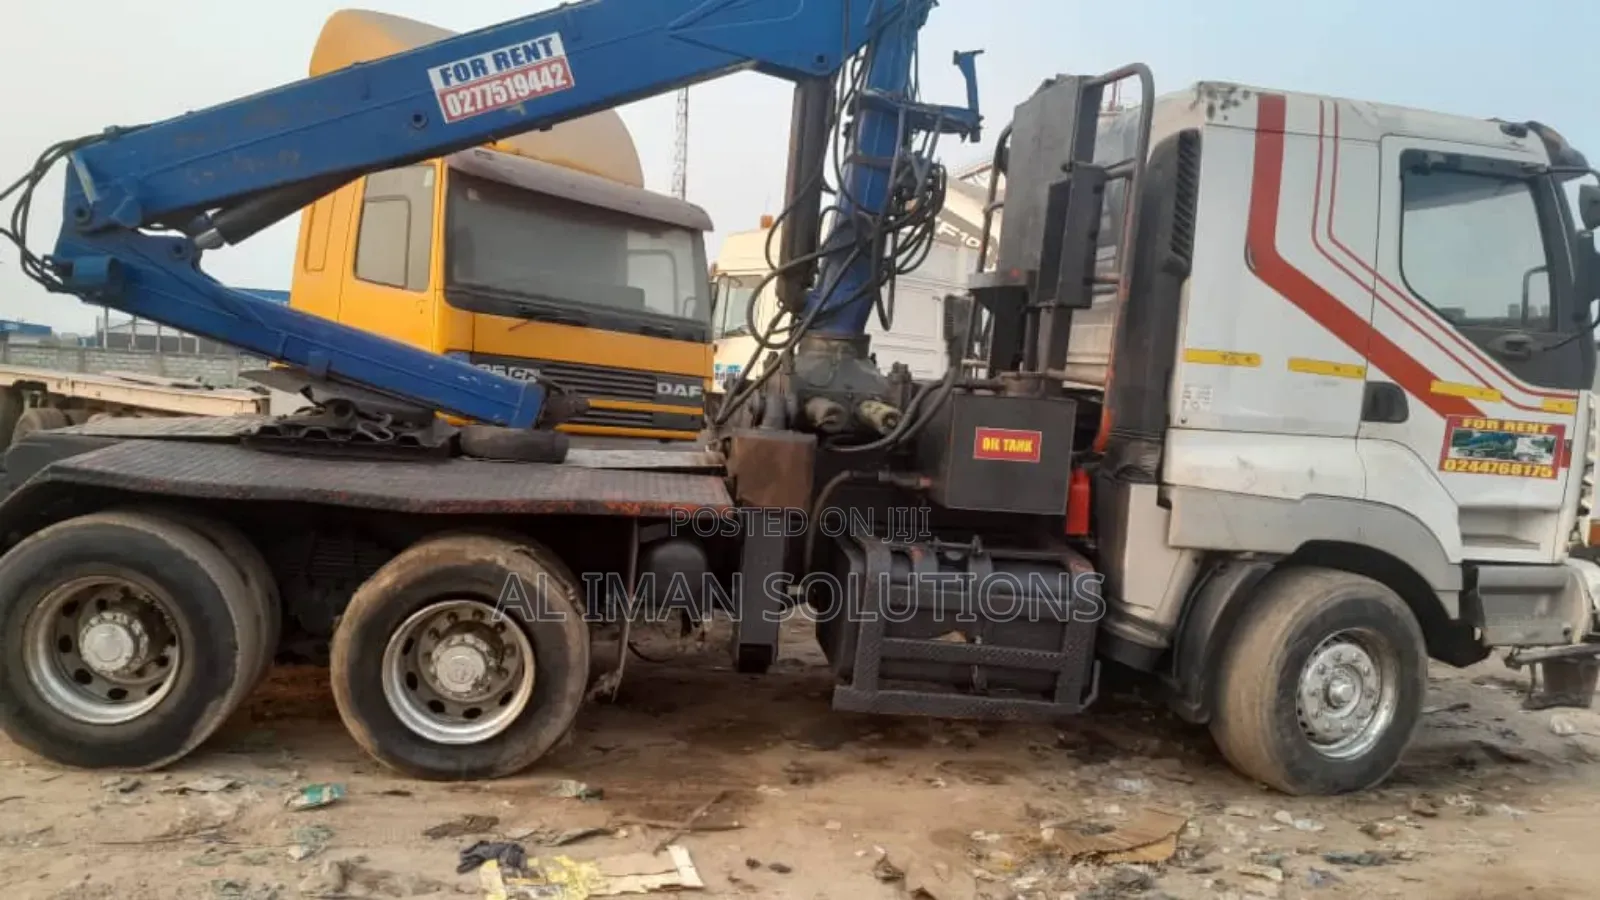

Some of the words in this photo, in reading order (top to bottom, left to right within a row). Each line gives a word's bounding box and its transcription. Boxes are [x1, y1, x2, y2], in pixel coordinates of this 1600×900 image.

[439, 57, 489, 87] FOR
[491, 37, 554, 72] RENT
[445, 62, 567, 118] 0277519442
[656, 381, 703, 398] DAF
[1461, 418, 1499, 430] FOR
[1503, 421, 1553, 433] RENT
[982, 436, 1000, 452] OIL
[1003, 438, 1033, 453] TANK
